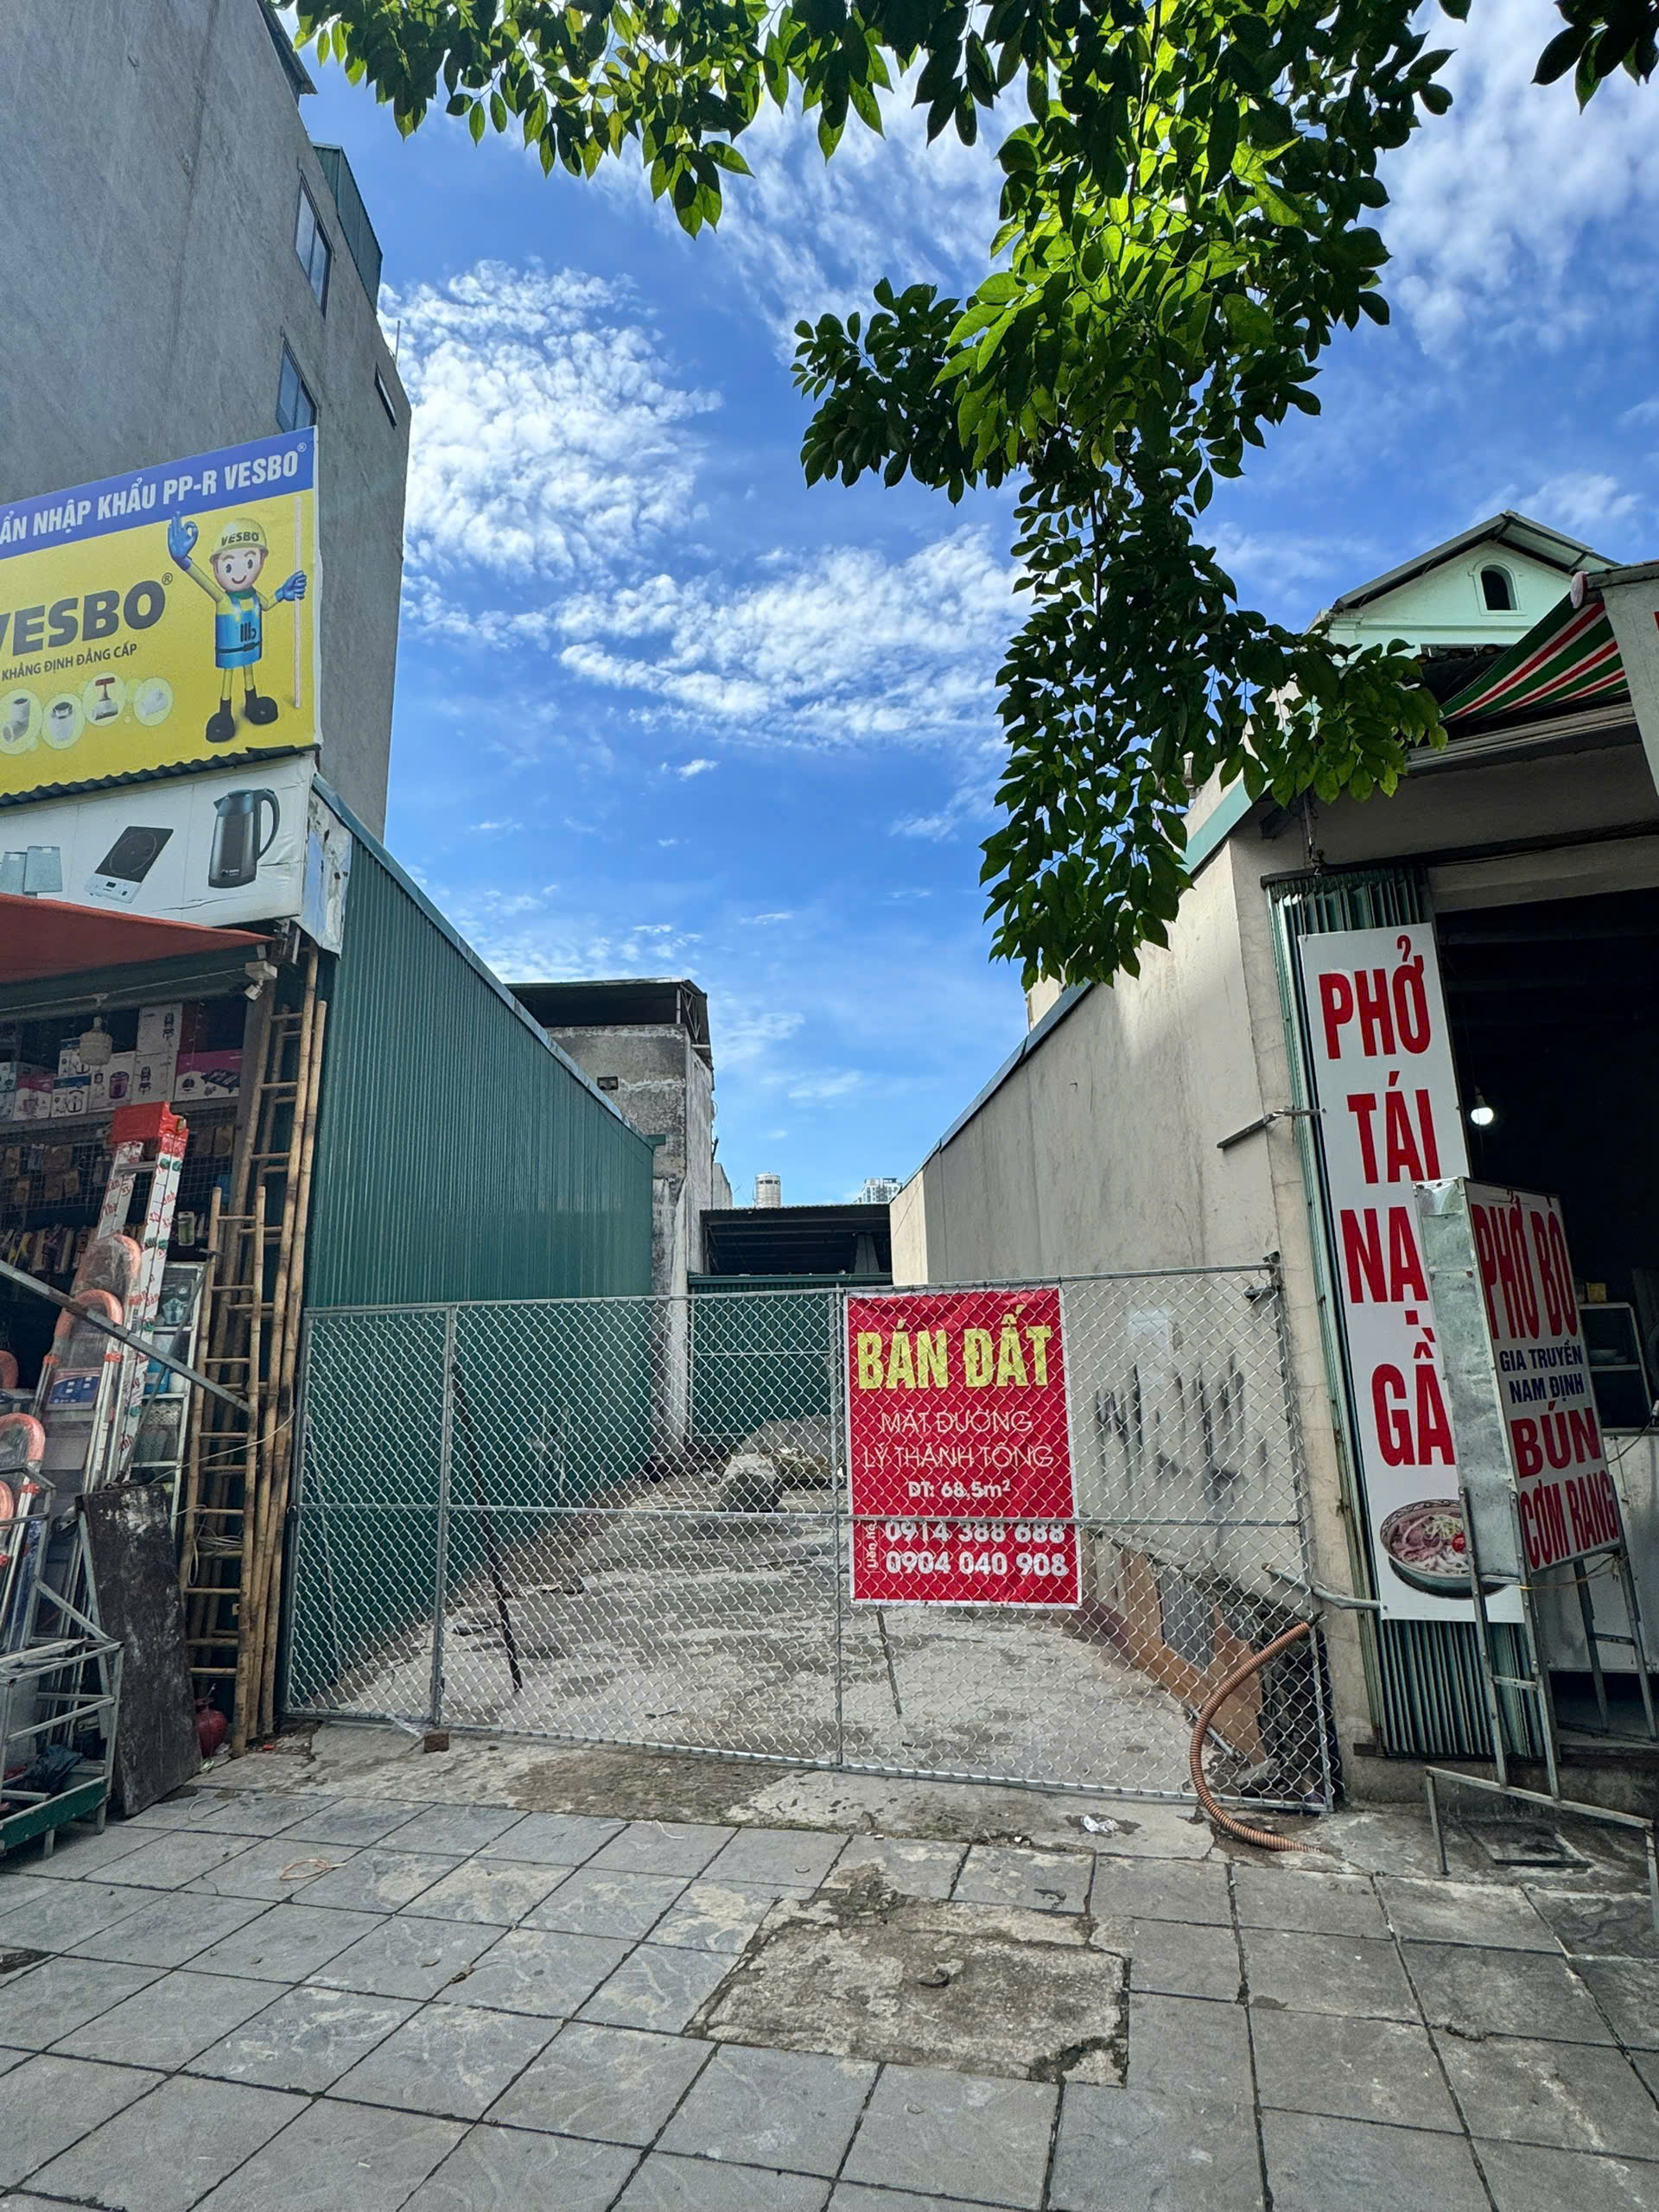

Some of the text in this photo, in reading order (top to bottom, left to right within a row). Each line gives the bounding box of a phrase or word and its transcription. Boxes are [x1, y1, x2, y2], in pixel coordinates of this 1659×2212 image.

[32, 499, 91, 536] NHẬP
[98, 477, 156, 520] KHẨU
[162, 469, 218, 505] PP-R
[221, 531, 260, 547] VESBO
[43, 657, 74, 674] ĐỊNH
[113, 640, 138, 656] CẤP
[1319, 935, 1432, 1059] PHỞ
[1347, 1071, 1441, 1185] TÁI
[1340, 1208, 1428, 1325] NẠ
[1471, 1188, 1579, 1340] PHỞ BÒ
[856, 1304, 1052, 1389] BÁN ĐẤT
[1499, 1339, 1584, 1372] GIA TRUYỀN
[1372, 1327, 1455, 1467] GẦ
[1509, 1372, 1586, 1404] NAM ĐỊNH
[1510, 1400, 1603, 1479] BÚN
[884, 1520, 950, 1542] 0914
[1520, 1471, 1619, 1570] CƠM RANG
[886, 1550, 1067, 1577] 0904 040 908
